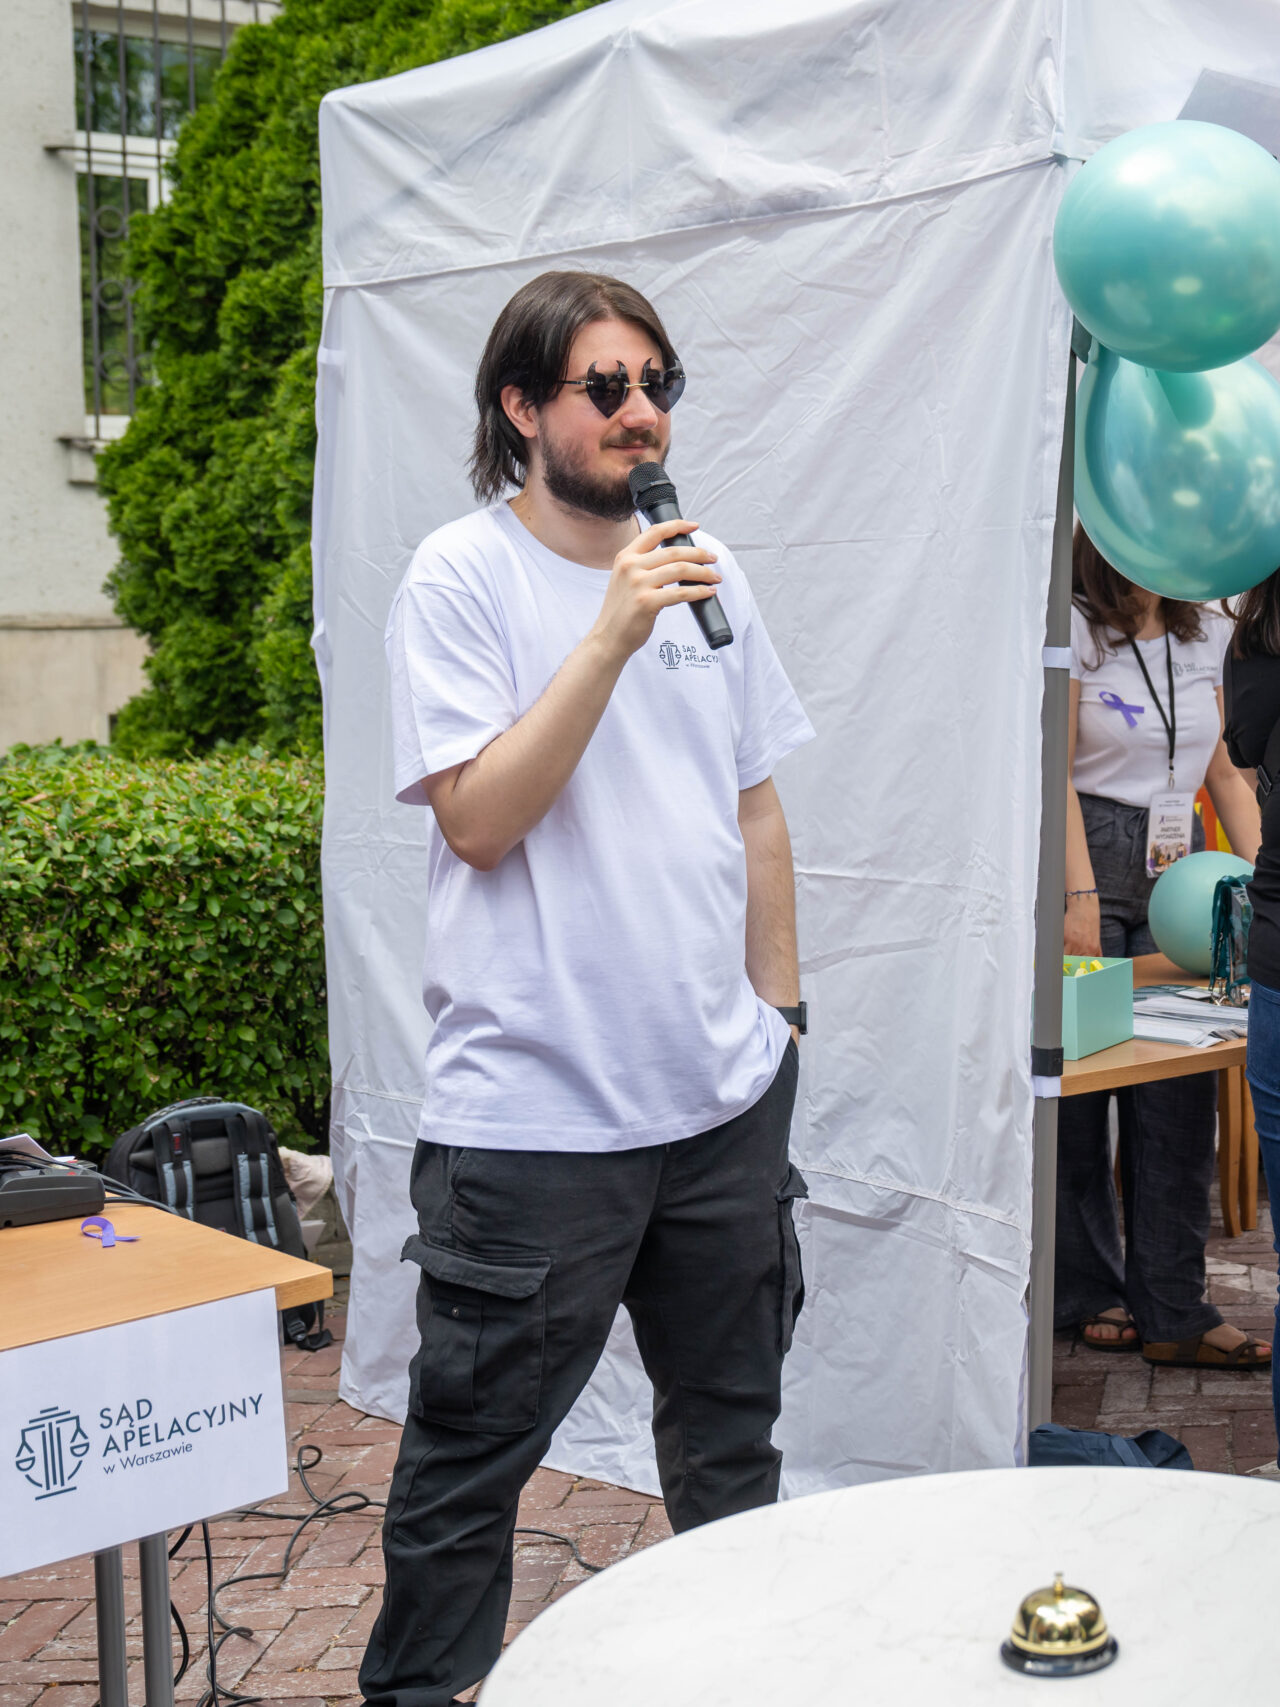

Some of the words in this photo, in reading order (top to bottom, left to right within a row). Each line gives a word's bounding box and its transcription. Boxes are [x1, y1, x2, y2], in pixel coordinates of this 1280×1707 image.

[100, 1398, 153, 1429] SĄD
[102, 1393, 263, 1457] APELACYJNY
[103, 1464, 115, 1475] w
[119, 1442, 193, 1470] Warszawie
